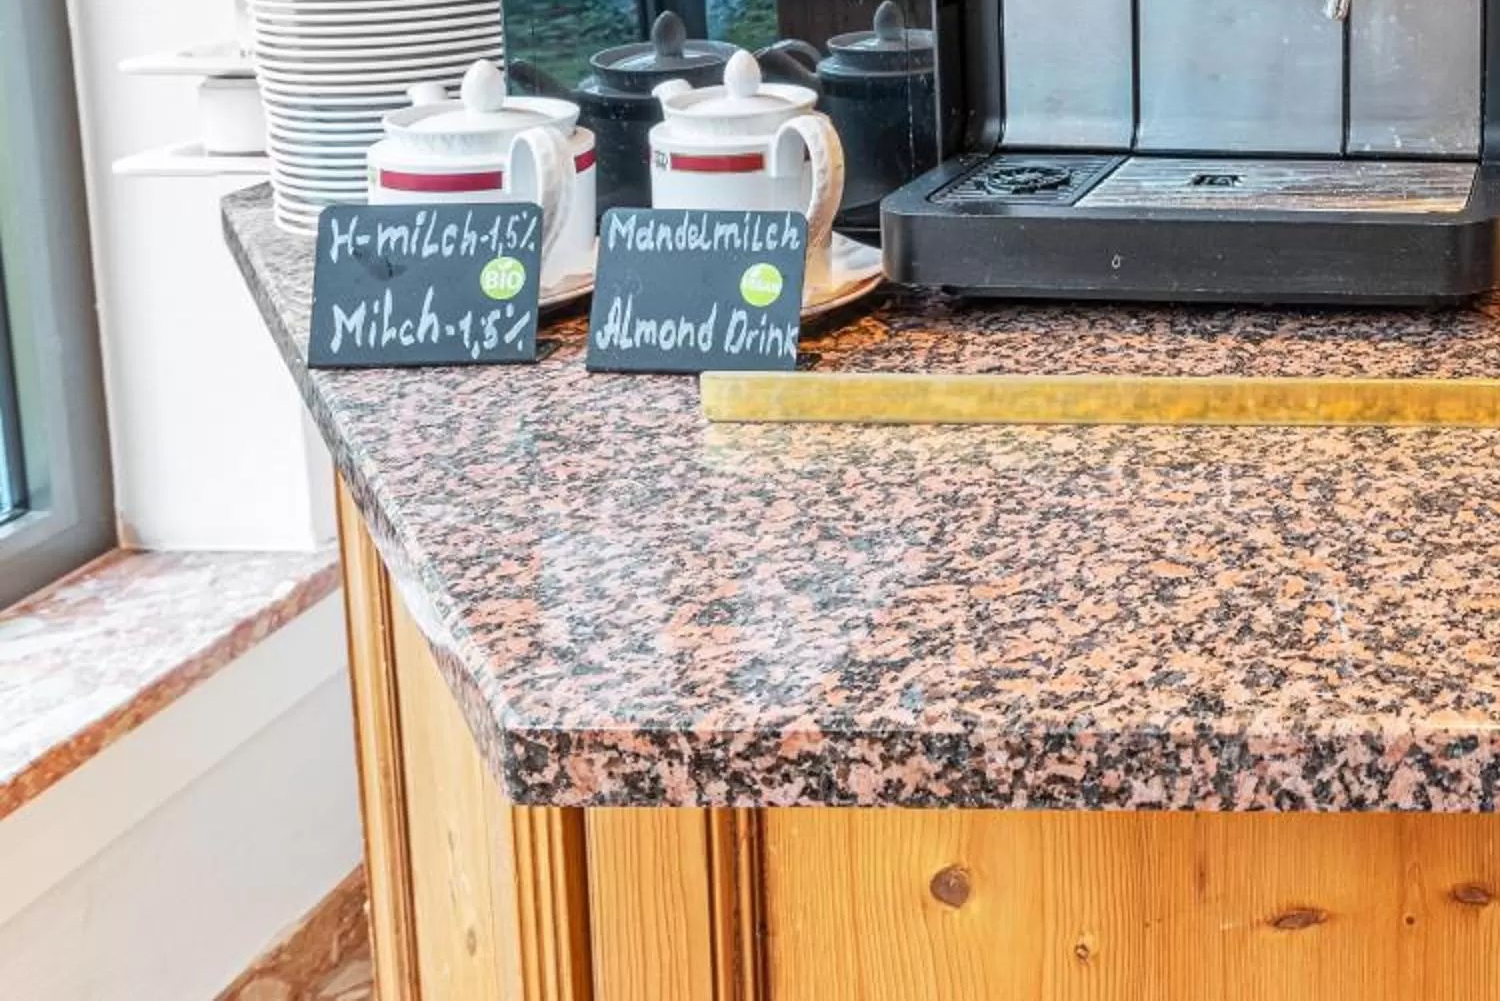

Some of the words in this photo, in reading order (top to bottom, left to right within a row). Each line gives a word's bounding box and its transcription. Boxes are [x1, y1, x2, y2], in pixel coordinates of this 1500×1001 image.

[487, 269, 523, 290] BIO
[596, 294, 718, 352] Almond
[724, 307, 799, 361] Drink
